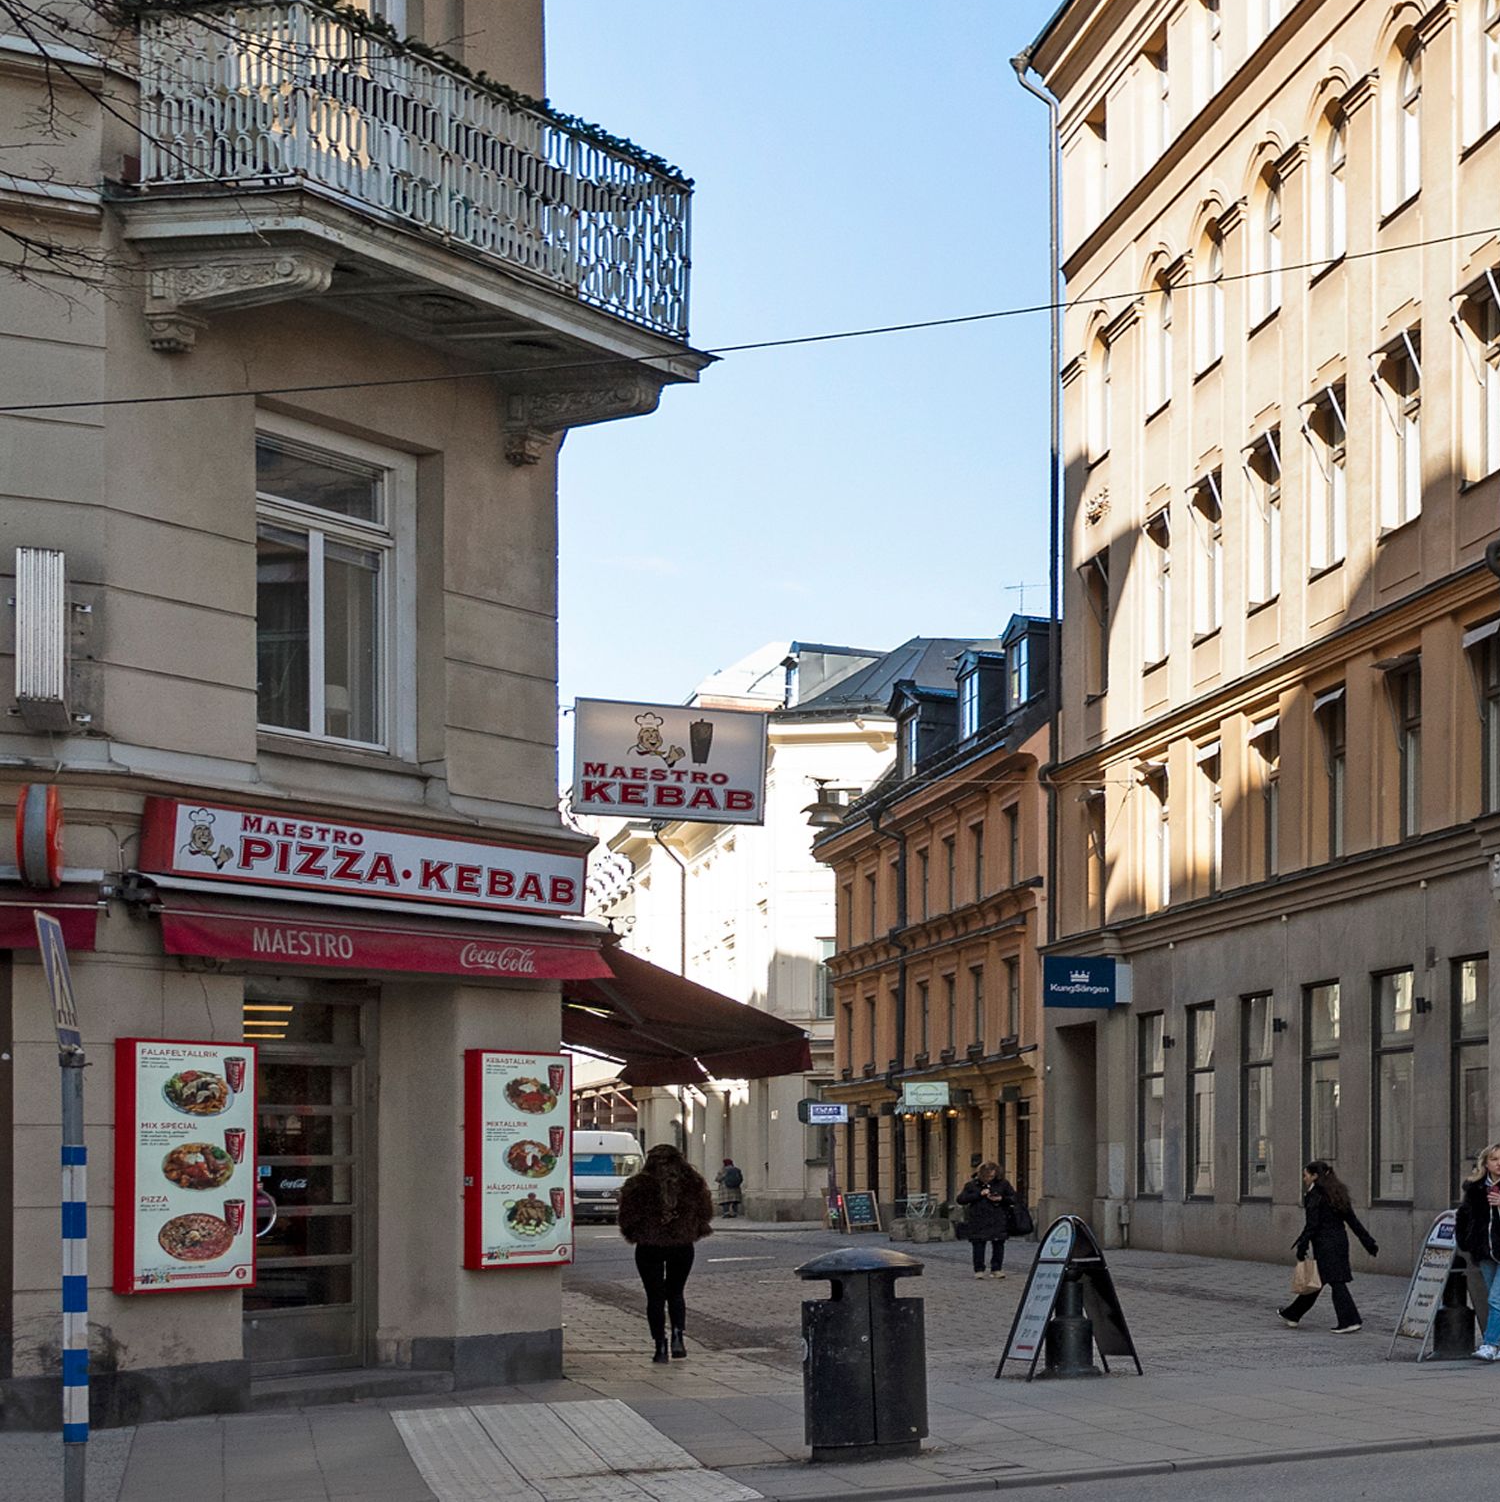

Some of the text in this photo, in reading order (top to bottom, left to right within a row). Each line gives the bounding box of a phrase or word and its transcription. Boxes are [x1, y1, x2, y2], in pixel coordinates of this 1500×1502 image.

[583, 762, 730, 785] MAESTRO
[581, 780, 756, 811] KEBAB
[241, 813, 364, 846] MAESTRO
[238, 836, 578, 906] PIZZA KEBAB
[252, 927, 354, 959] MAESTRO
[1050, 984, 1110, 994] KungSängen
[141, 1049, 218, 1058] FALAFELTALLRIK
[141, 1122, 198, 1130] MIX SPECIAL
